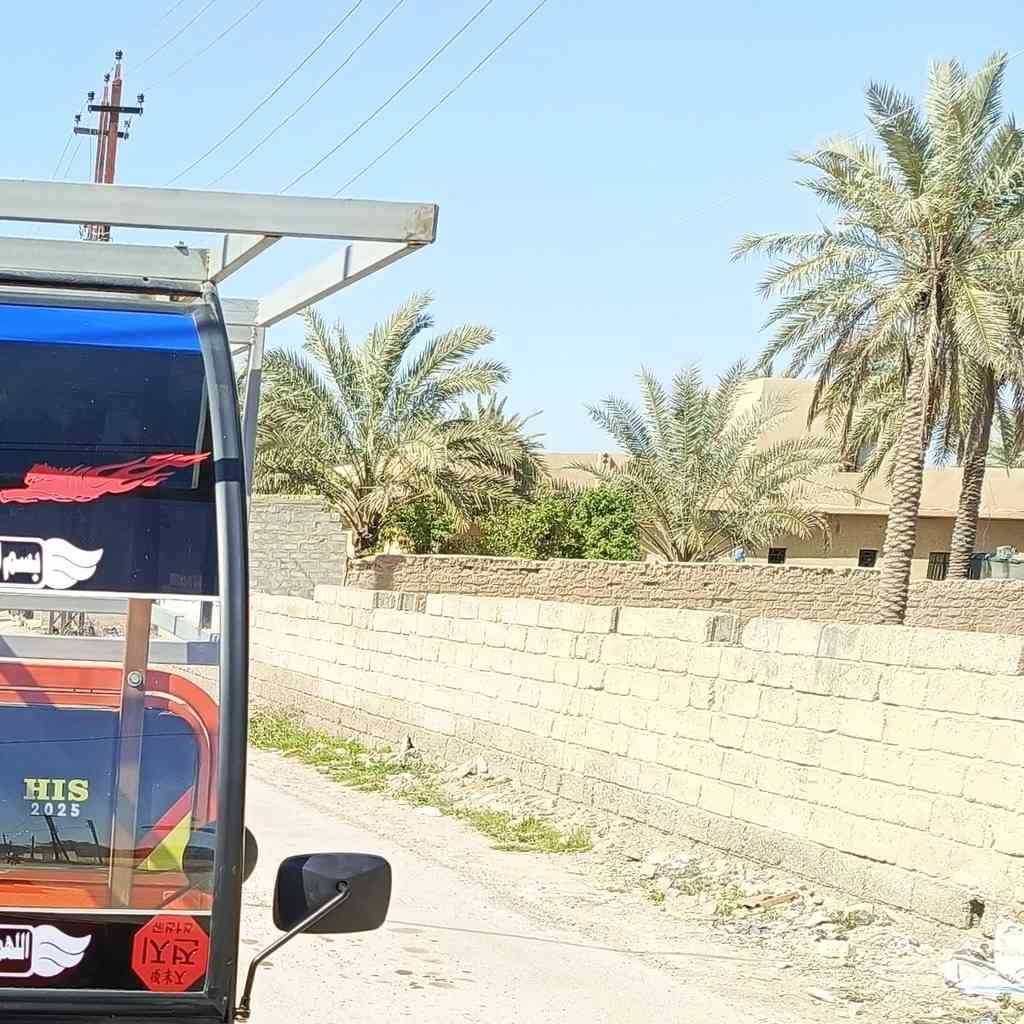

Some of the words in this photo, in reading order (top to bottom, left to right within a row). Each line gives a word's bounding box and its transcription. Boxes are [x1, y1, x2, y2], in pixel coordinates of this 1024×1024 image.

[3, 551, 40, 581] بسم
[23, 778, 89, 802] HIS
[30, 802, 81, 817] 2025
